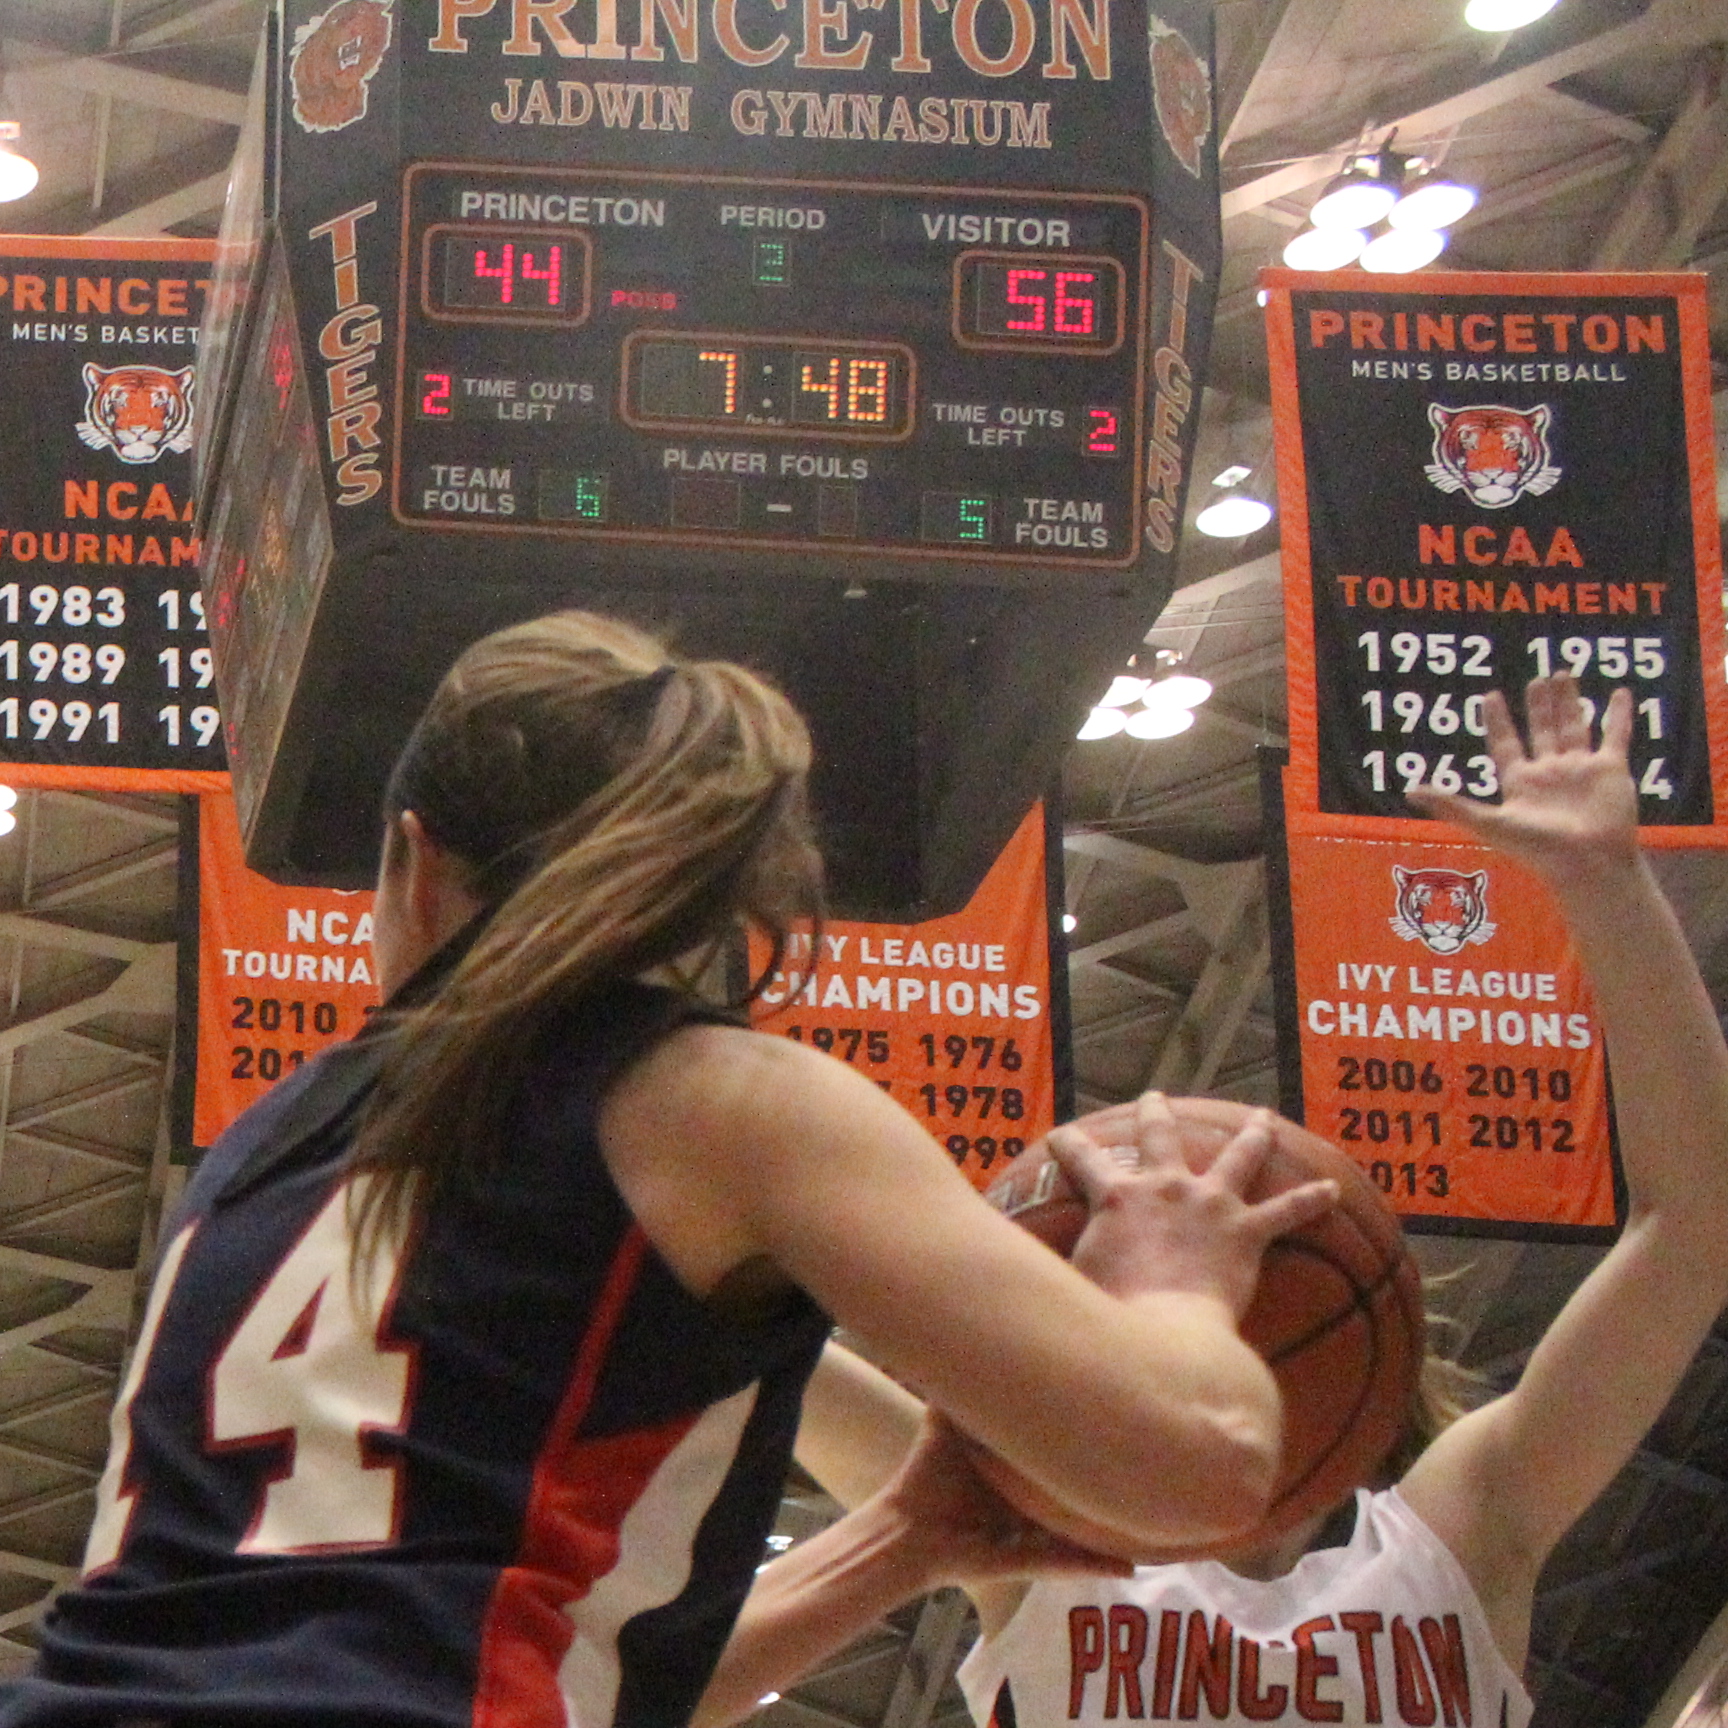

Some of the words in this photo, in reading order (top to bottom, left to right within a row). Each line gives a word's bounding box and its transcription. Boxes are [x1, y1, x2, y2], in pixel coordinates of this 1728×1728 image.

[428, 0, 1111, 81] PRINCETON
[491, 79, 693, 132] JADWIN
[731, 90, 1052, 149] GYMNASIUM
[460, 191, 665, 226] PRINCETON
[720, 206, 826, 230] PERIOD
[922, 213, 1071, 247] VISITOR
[474, 244, 562, 305] 44
[758, 242, 785, 282] 2
[1006, 269, 1094, 334] 56
[12, 323, 89, 343] MEN'S
[101, 325, 201, 345] BASKET
[1310, 310, 1666, 354] PRINCETON
[309, 201, 383, 506] TIGERS
[1351, 359, 1432, 381] MEN'S
[1446, 360, 1627, 383] BASKETBALL
[423, 373, 452, 415] 2
[463, 378, 516, 398] TIME
[530, 381, 594, 402] OUTS
[1147, 241, 1204, 553] TIGERS
[497, 402, 556, 421] LEFT
[933, 403, 987, 423] TIME
[1000, 407, 1065, 428] OUTS
[1089, 410, 1116, 451] 2
[968, 429, 1027, 447] LEFT
[432, 465, 511, 488] TEAM
[664, 449, 766, 474] PLAYER
[780, 454, 869, 480] FOULS
[423, 491, 516, 515] FOULS
[1024, 498, 1104, 524] TEAM
[1015, 523, 1109, 549] FOULS
[1419, 525, 1584, 569] NCAA
[158, 589, 206, 630] 19
[1336, 574, 1668, 615] TOURNAMENT
[158, 647, 214, 689] 19
[1358, 631, 1493, 677] 1952
[1527, 636, 1666, 679] 1955
[158, 704, 221, 746] 19
[1362, 750, 1498, 797] 1963
[286, 908, 375, 945] NCA
[222, 948, 373, 985] TOURNA
[790, 933, 848, 963] IVY
[860, 937, 1006, 972] LEAGUE
[761, 971, 1042, 1020] CHAMPIONS
[1337, 962, 1397, 992] IVY
[1409, 966, 1558, 1001] LEAGUE
[231, 996, 337, 1034] 2010
[1307, 1000, 1591, 1049] CHAMPIONS
[919, 1033, 1022, 1072] 1976
[1337, 1056, 1442, 1094] 2006
[1466, 1064, 1572, 1102] 2010
[919, 1083, 1024, 1120] 1978
[1339, 1108, 1441, 1146] 2011
[1468, 1114, 1575, 1153] 2012
[1371, 1161, 1450, 1198] 013
